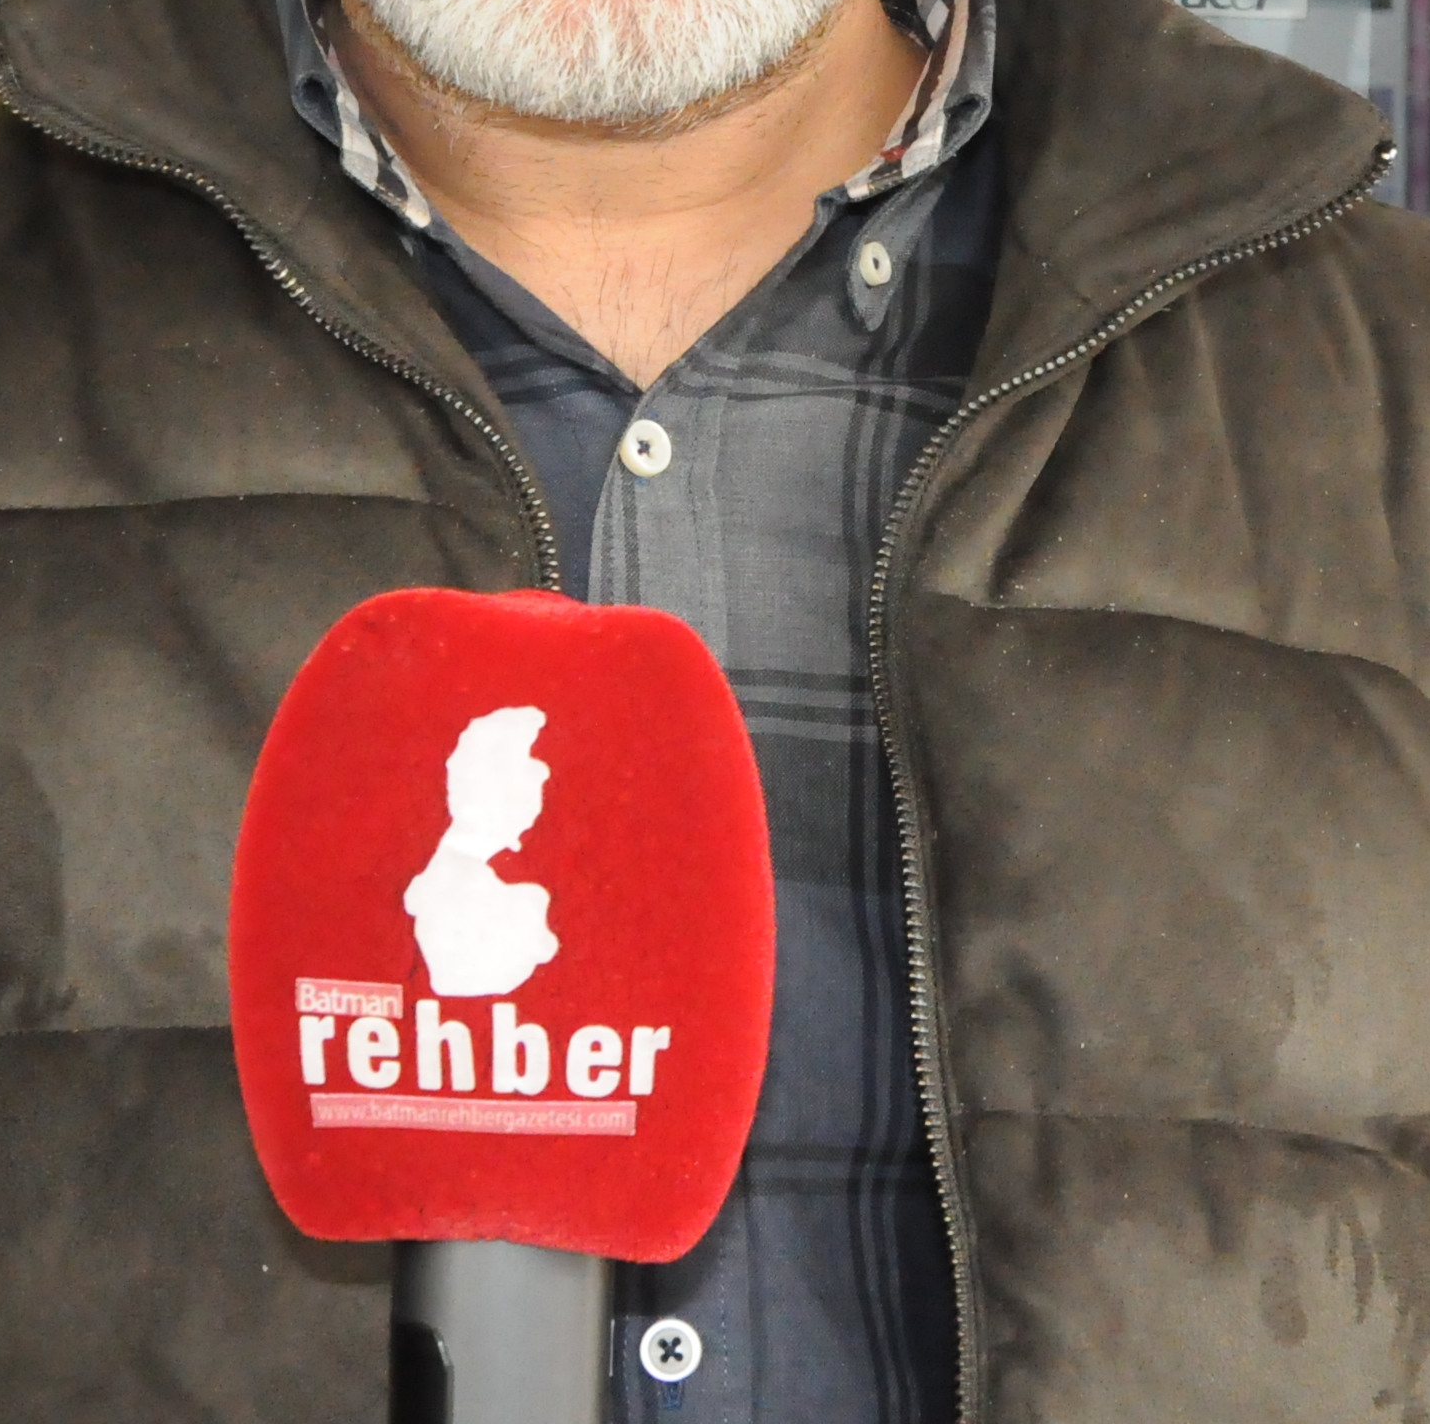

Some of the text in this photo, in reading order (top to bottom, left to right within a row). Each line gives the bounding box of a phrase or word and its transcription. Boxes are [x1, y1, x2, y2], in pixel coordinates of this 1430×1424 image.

[299, 983, 400, 1017] Batman
[298, 998, 671, 1098] rehber
[317, 1100, 627, 1133] www.batmanrehbergazetesi.com
